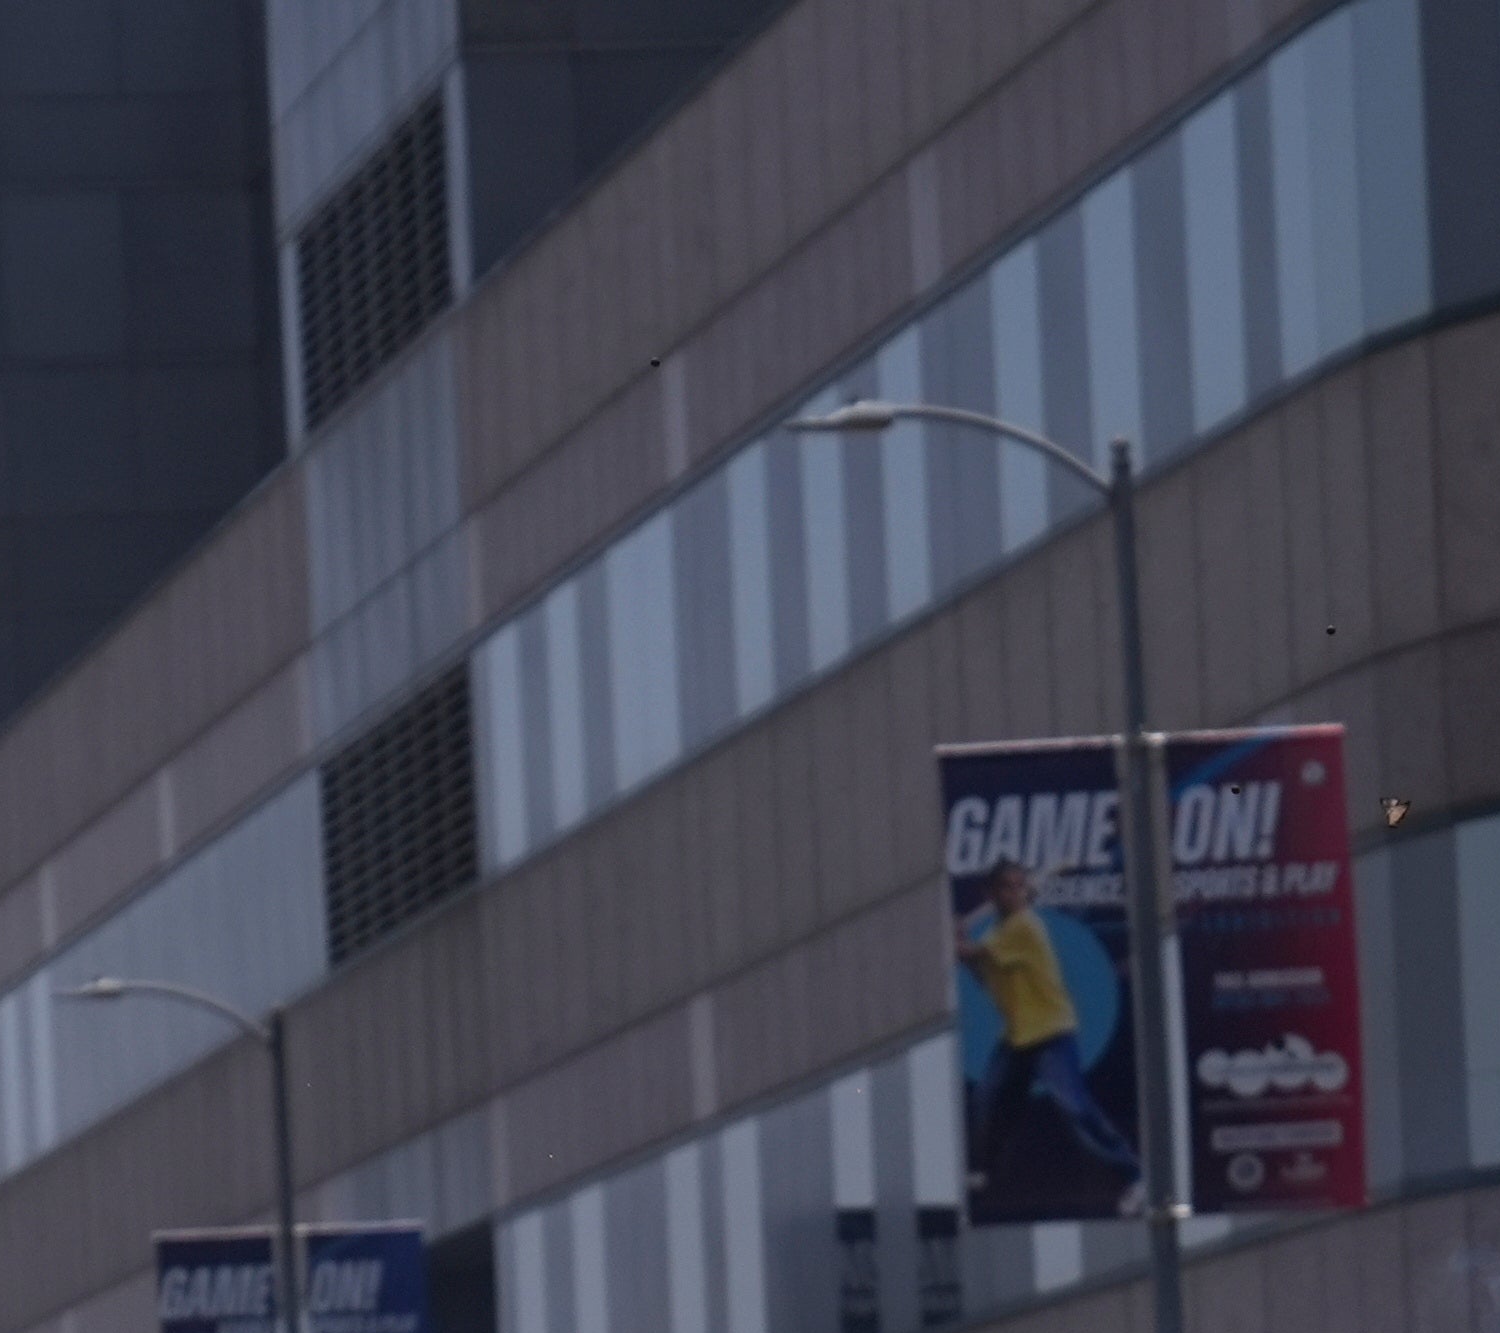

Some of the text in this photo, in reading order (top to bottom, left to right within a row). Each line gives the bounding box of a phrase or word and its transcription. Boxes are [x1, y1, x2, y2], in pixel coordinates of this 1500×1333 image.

[947, 781, 1282, 875] GAME ON!
[1283, 860, 1338, 896] PLAY
